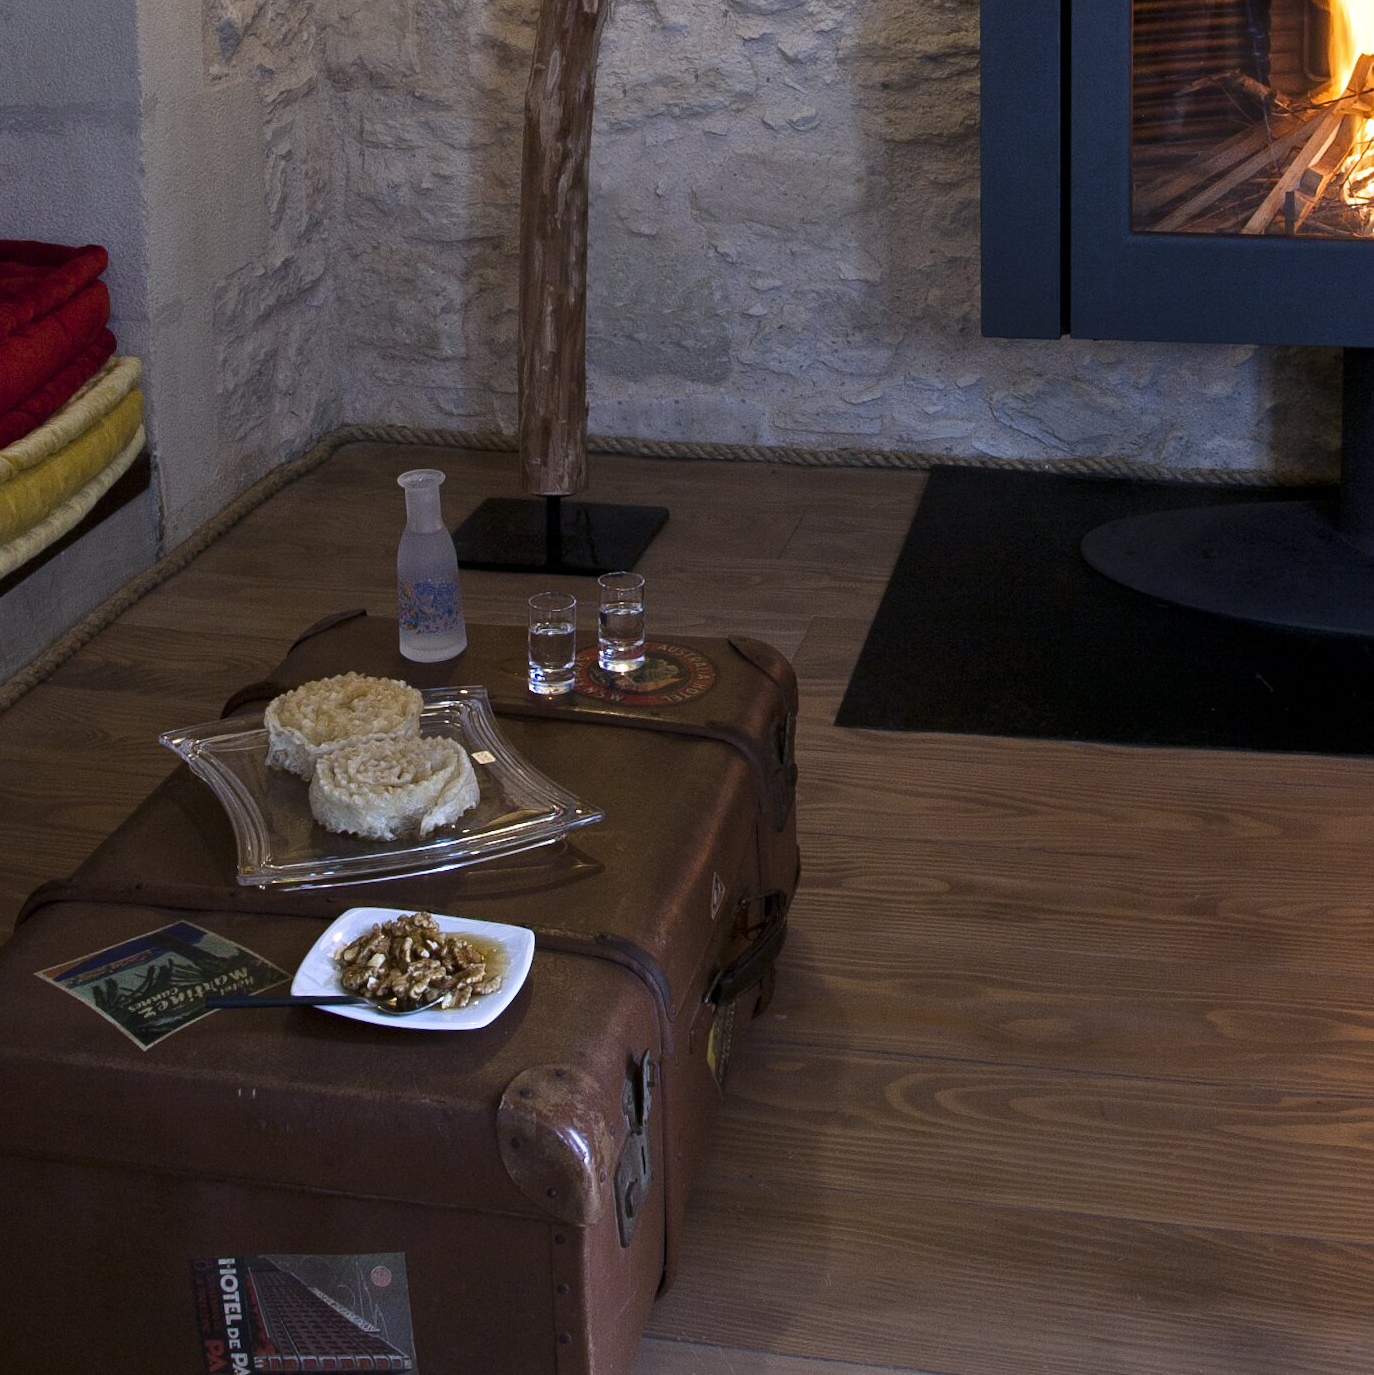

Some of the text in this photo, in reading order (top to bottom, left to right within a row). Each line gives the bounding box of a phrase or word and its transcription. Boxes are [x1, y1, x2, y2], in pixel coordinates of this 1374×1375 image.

[657, 644, 711, 703] AUSTRALIA HOTEL
[137, 967, 248, 1018] Martinez
[218, 1257, 243, 1326] HOTEL
[227, 1328, 242, 1349] DE
